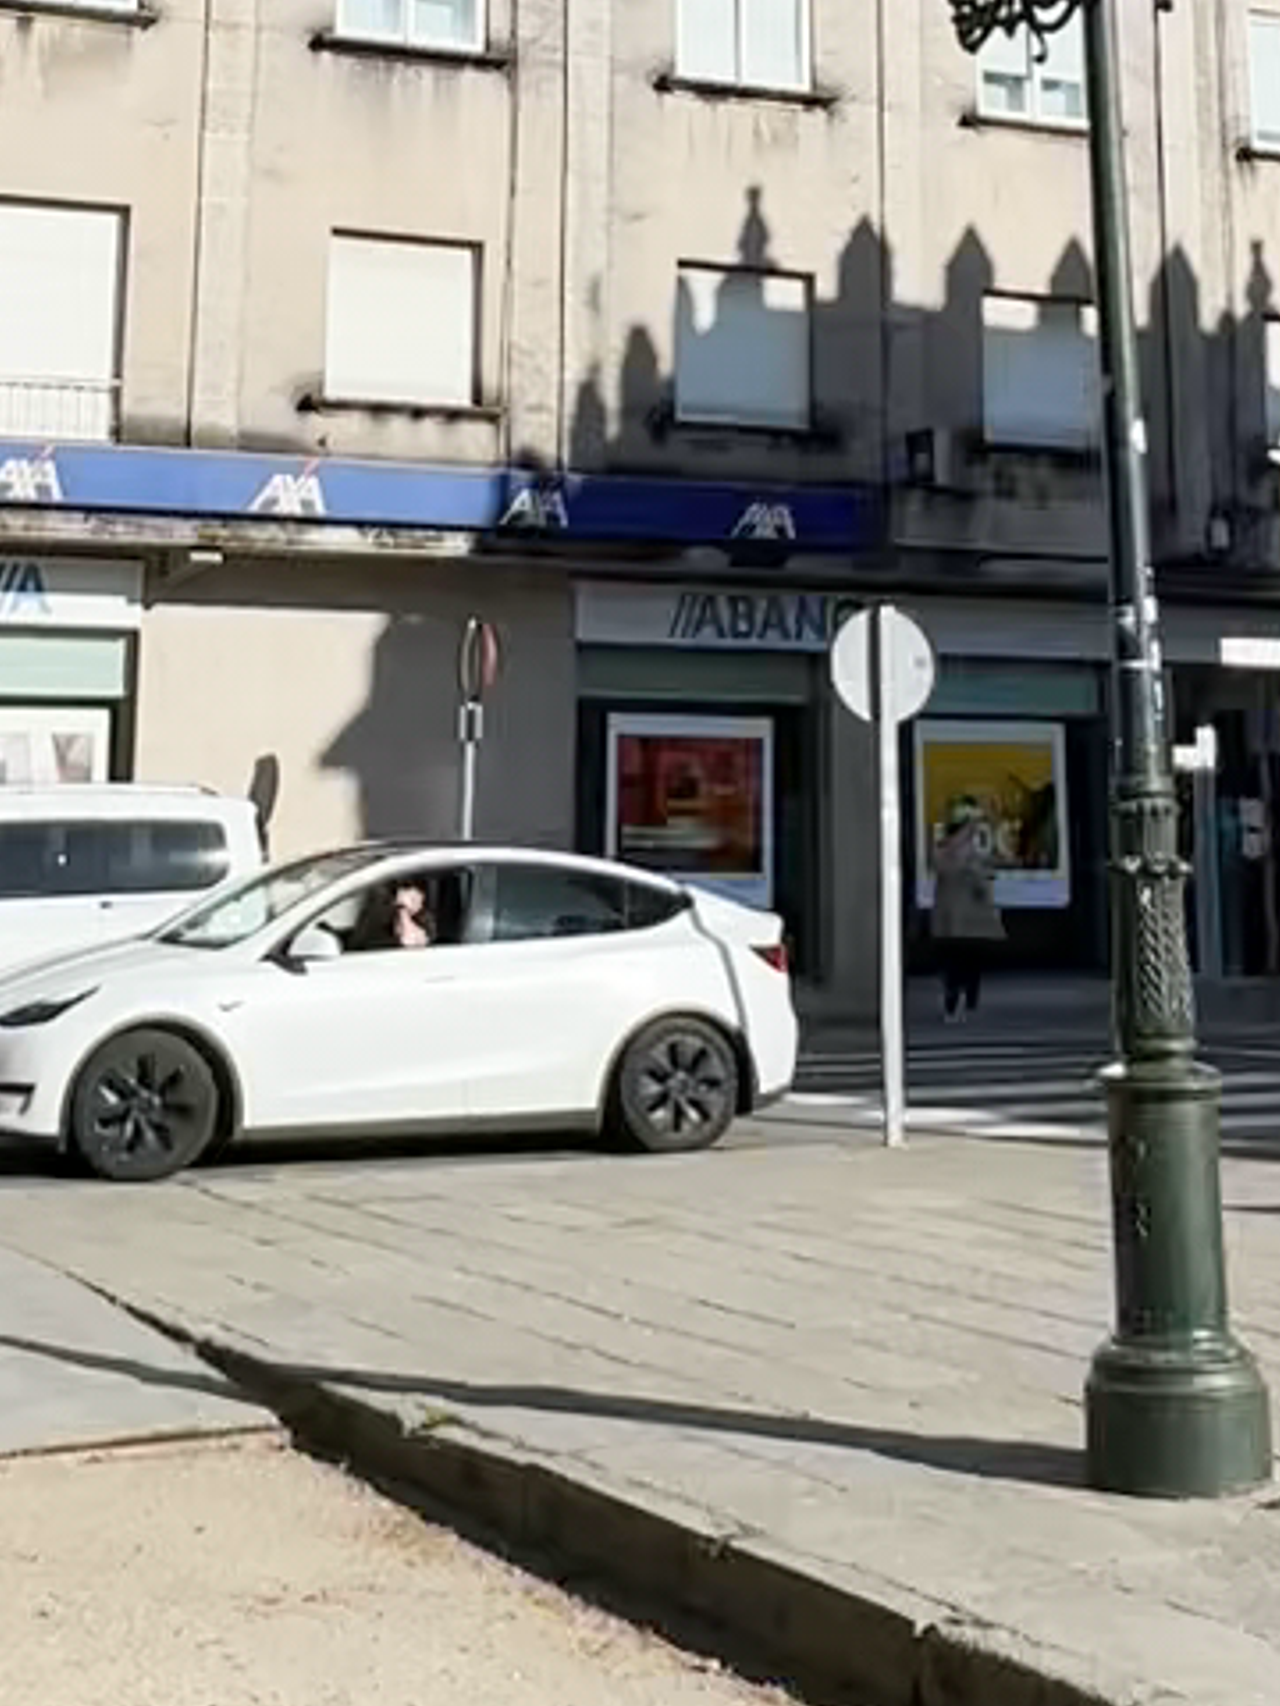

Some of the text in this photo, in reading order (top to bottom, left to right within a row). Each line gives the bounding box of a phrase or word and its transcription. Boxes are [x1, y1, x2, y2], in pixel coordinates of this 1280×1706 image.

[246, 473, 327, 516] AXA
[499, 485, 569, 529] AXA
[730, 500, 796, 539] AXA
